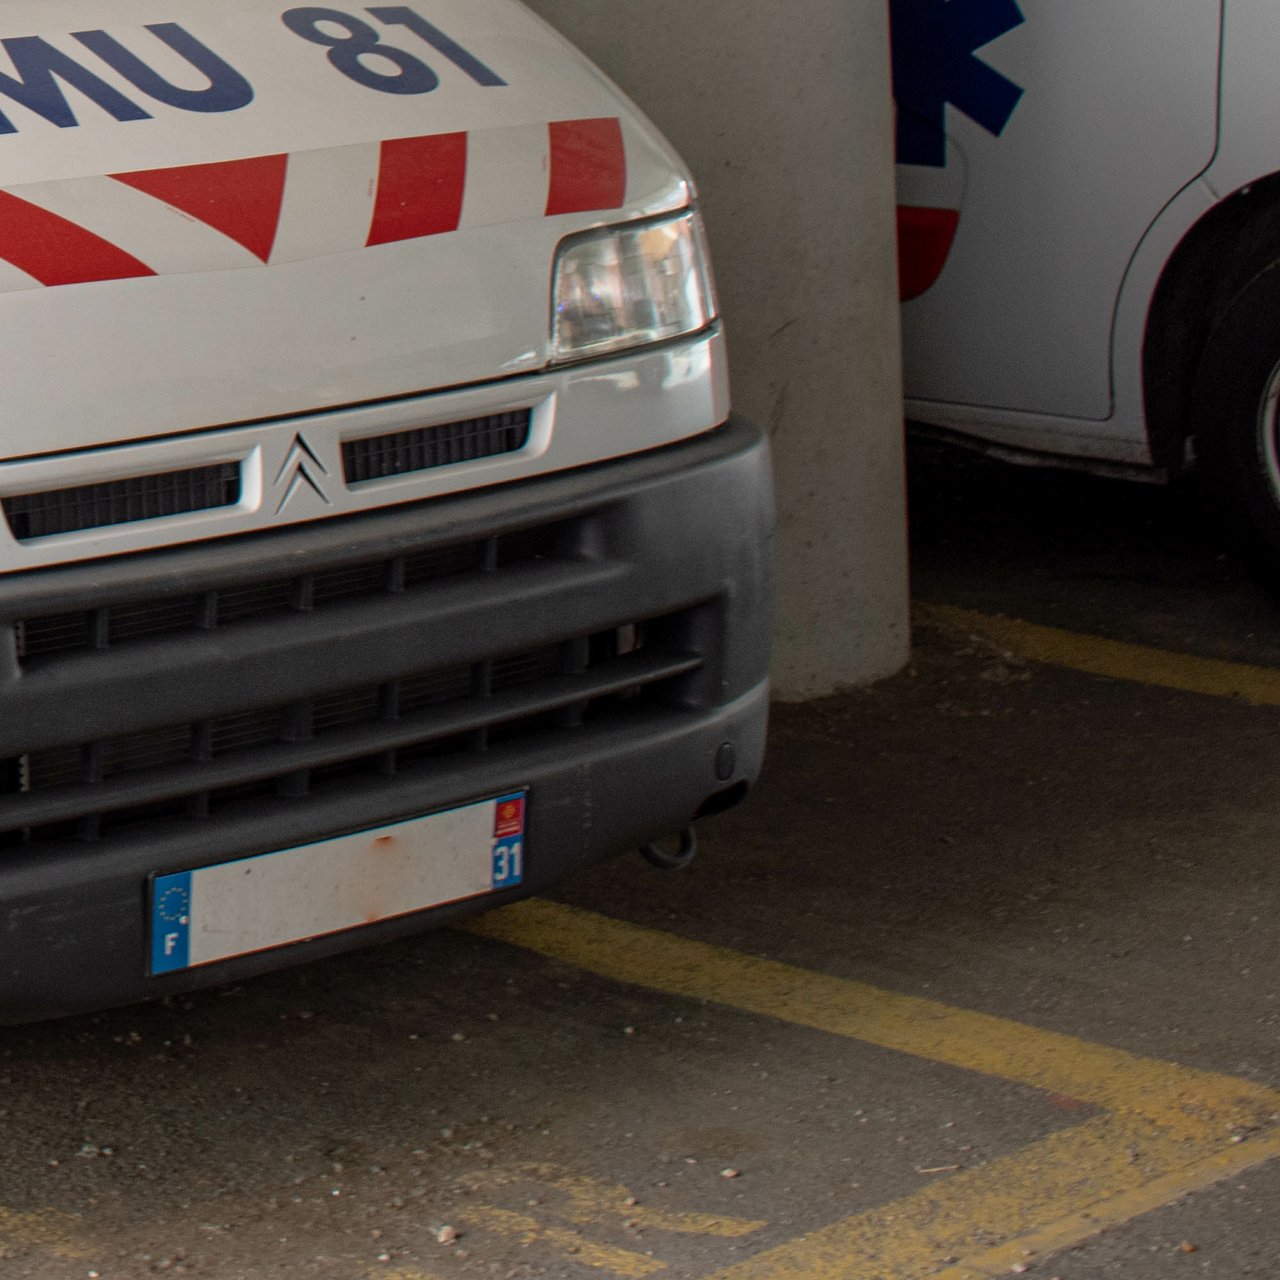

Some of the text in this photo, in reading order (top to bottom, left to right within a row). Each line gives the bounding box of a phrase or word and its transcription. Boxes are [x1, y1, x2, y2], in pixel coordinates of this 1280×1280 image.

[281, 5, 507, 96] 81
[494, 842, 521, 881] 31
[164, 932, 178, 956] F
